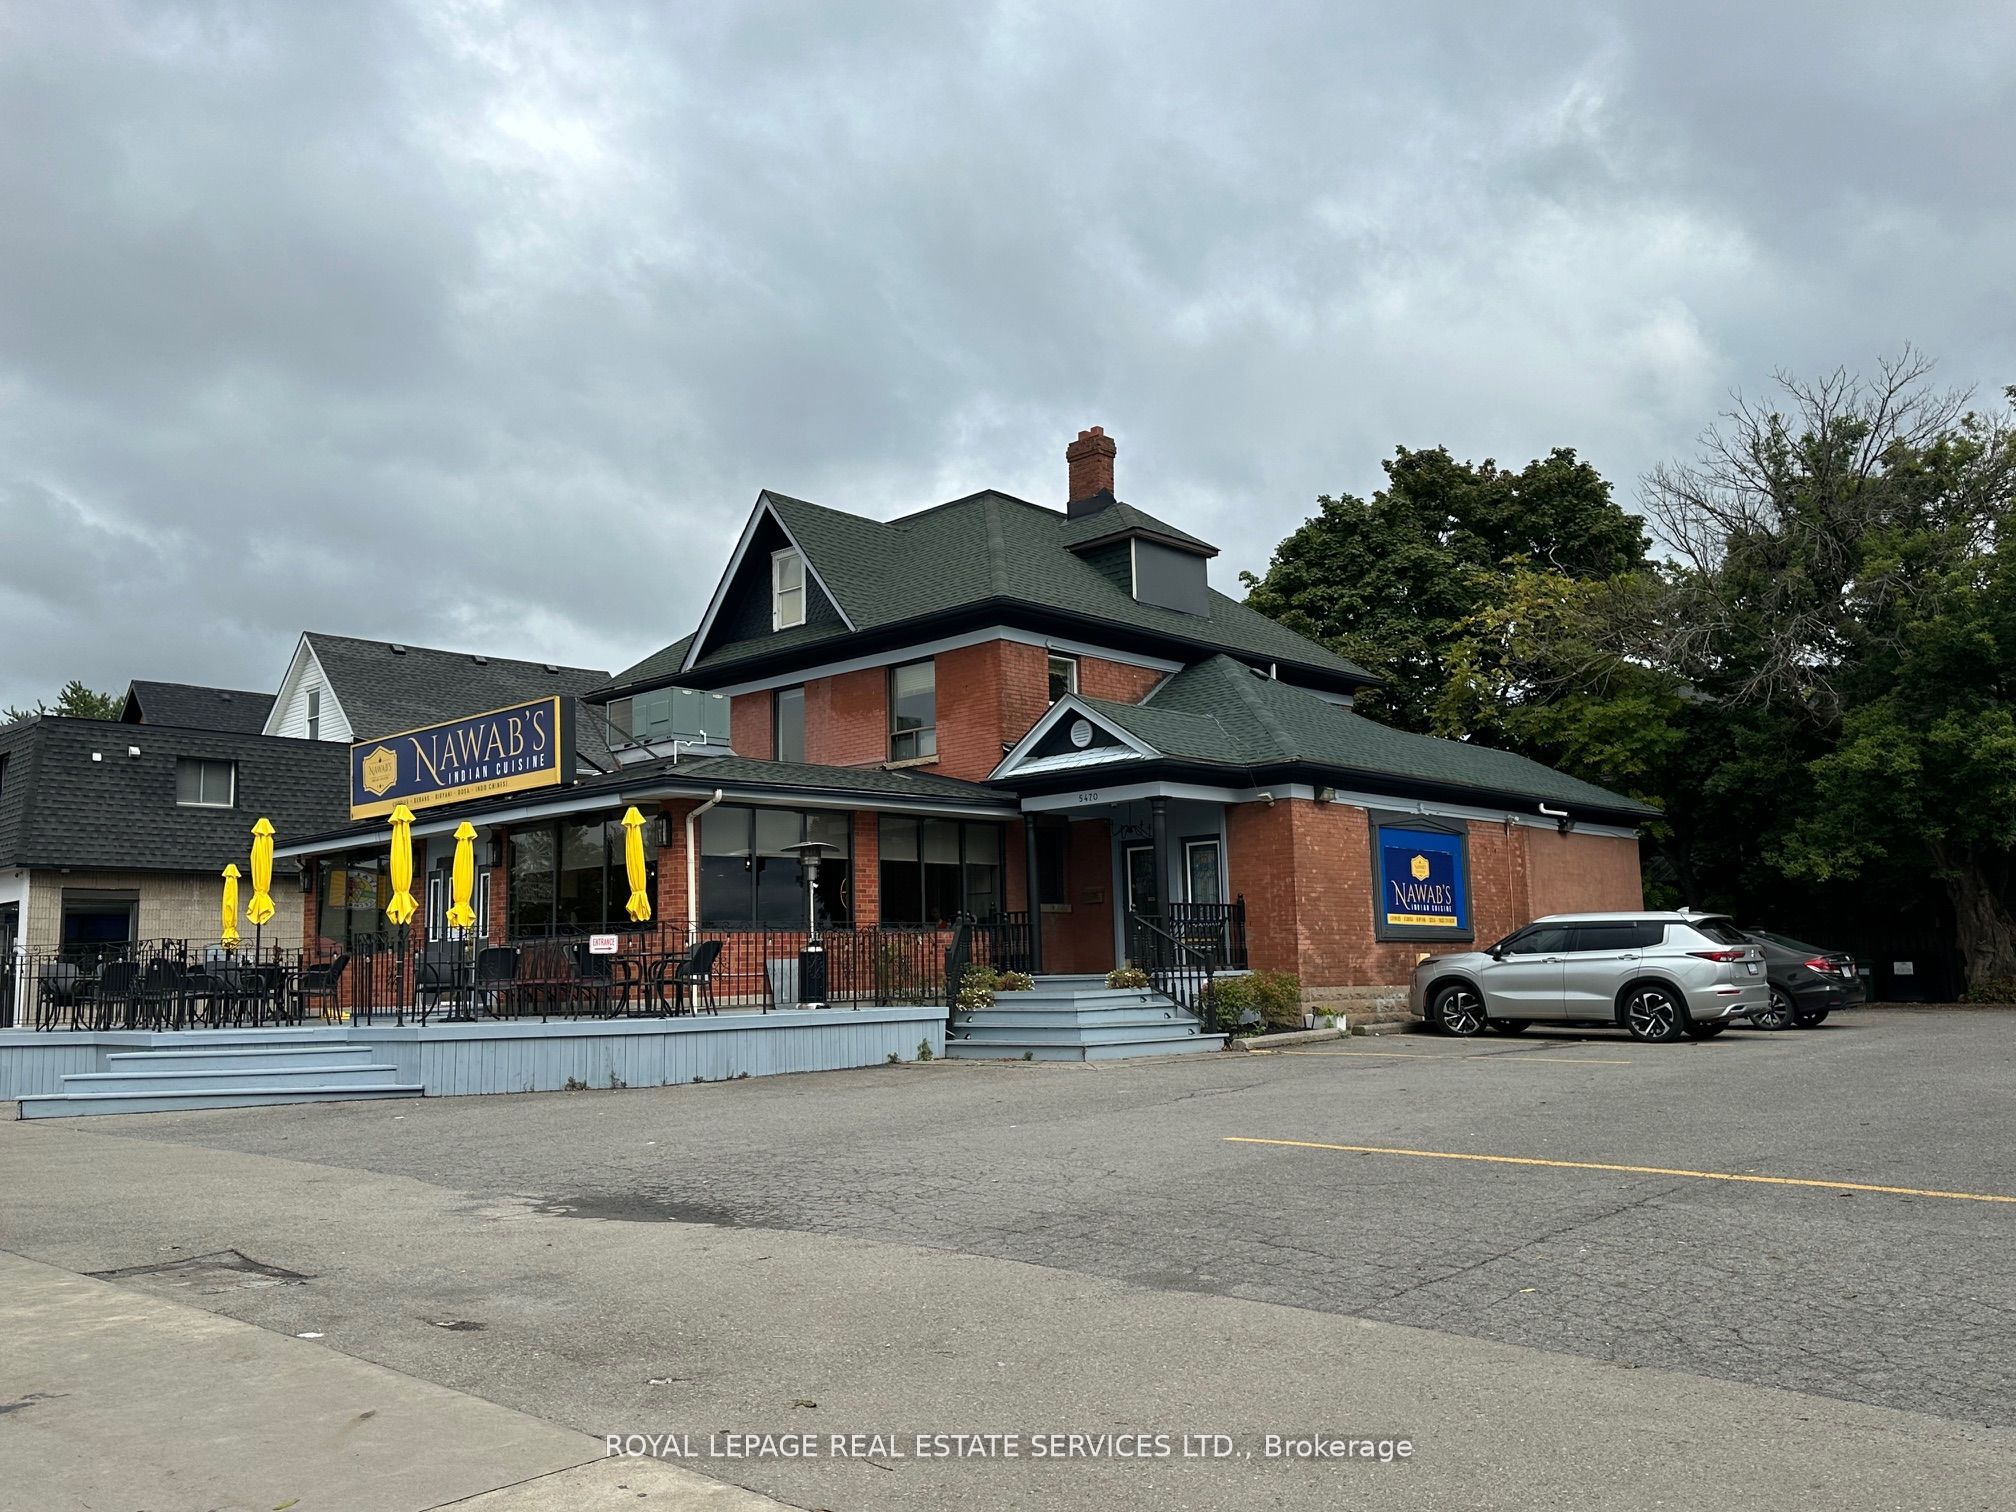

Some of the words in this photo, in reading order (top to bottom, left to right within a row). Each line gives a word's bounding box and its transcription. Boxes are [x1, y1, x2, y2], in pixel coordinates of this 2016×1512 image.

[408, 709, 546, 786] NAWAB'S
[448, 765, 488, 785] INDIAN
[496, 753, 545, 776] CUISINE
[1079, 792, 1098, 802] 5470
[1391, 880, 1452, 911] NAWAB'S
[592, 938, 616, 947] ENTRANCE
